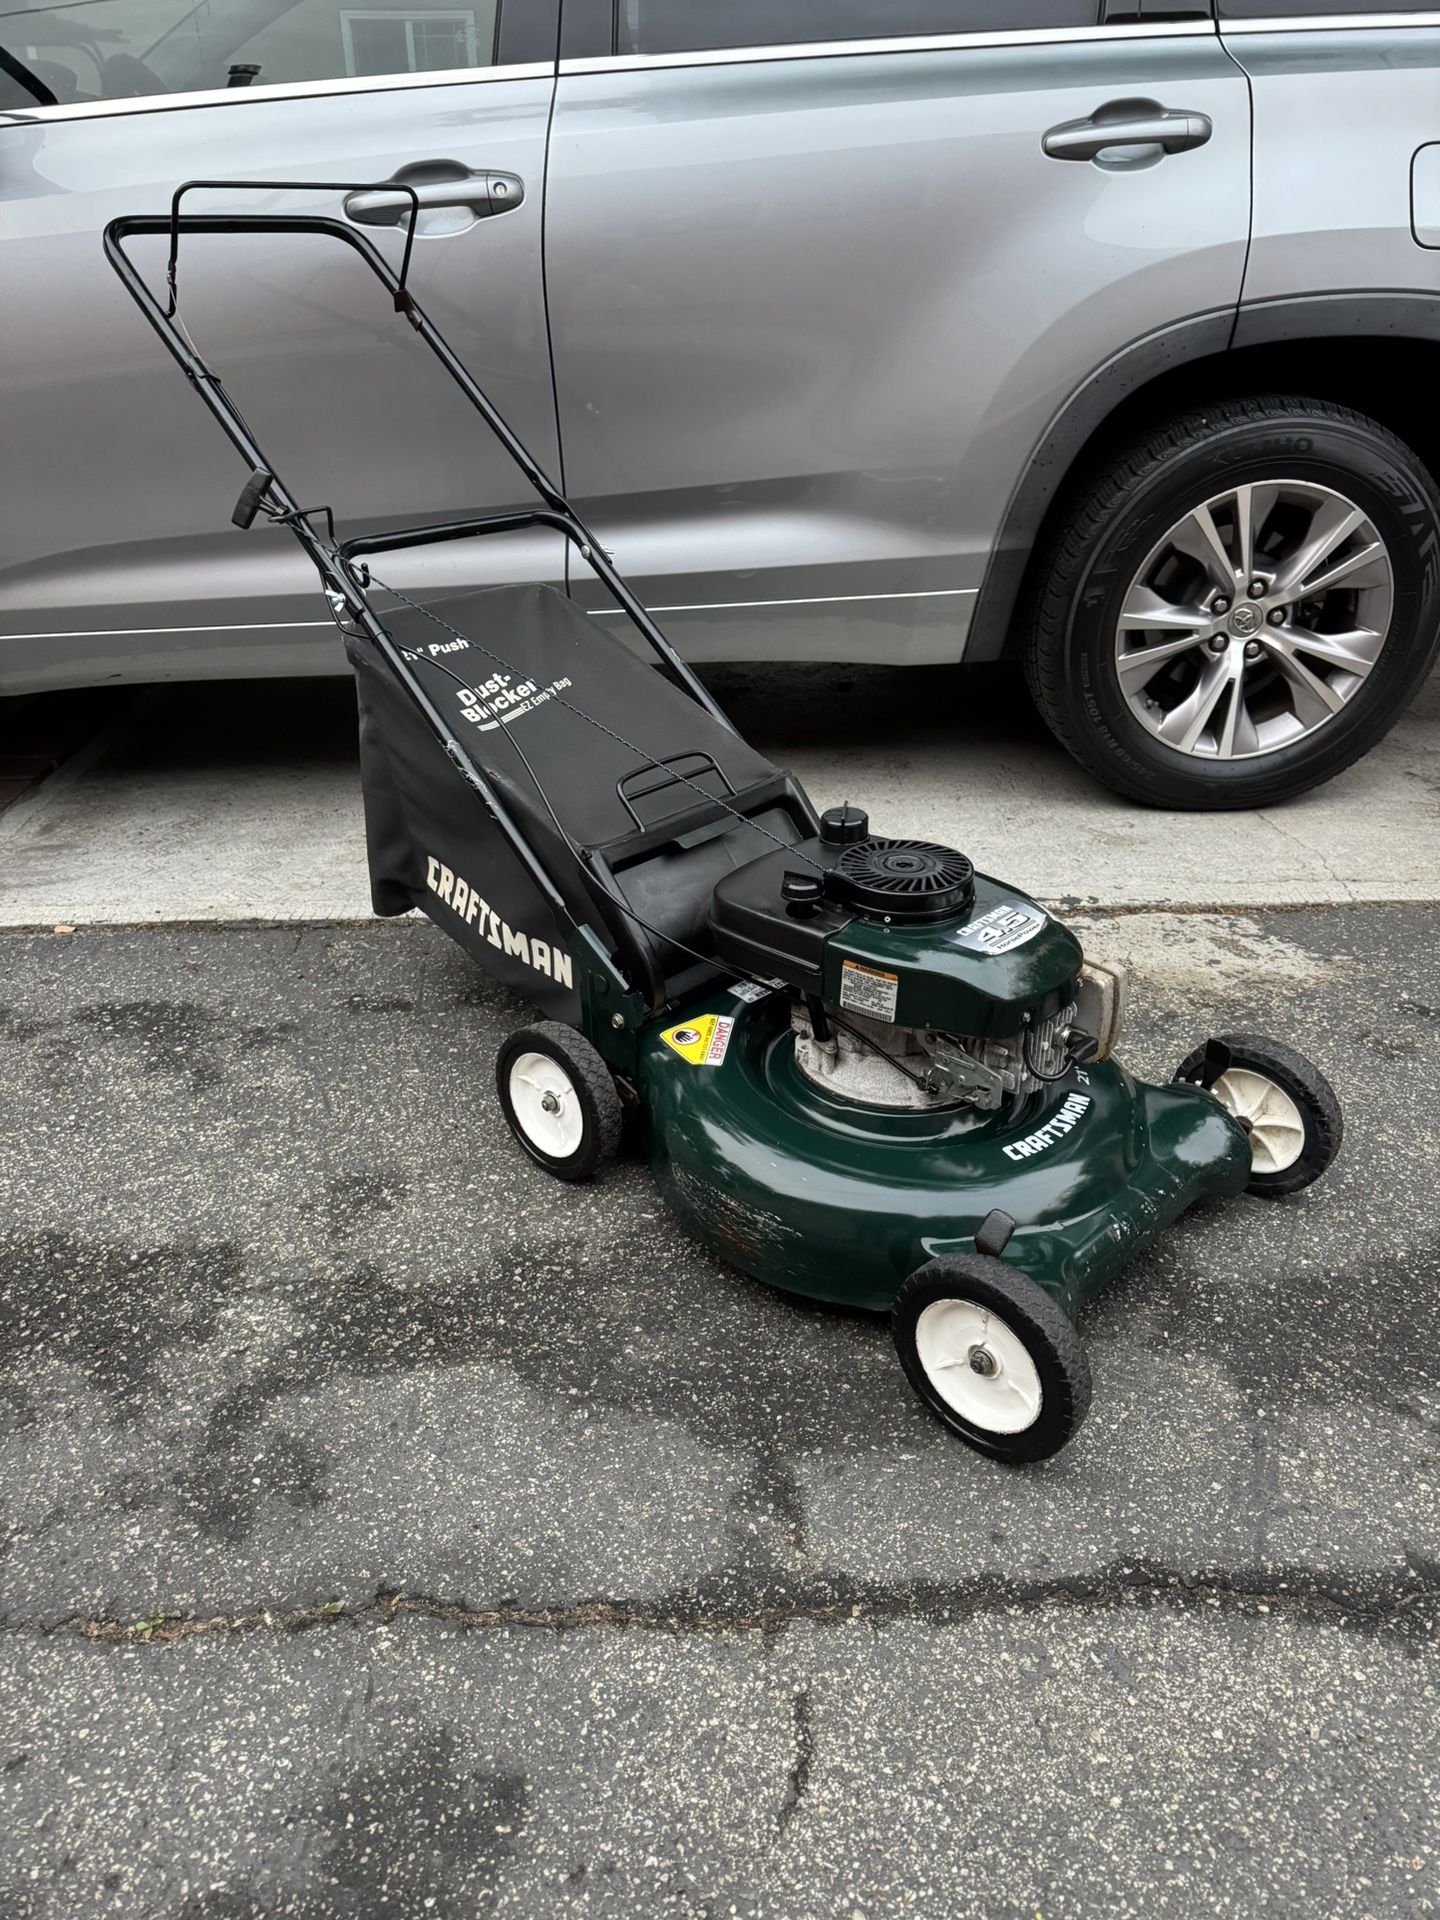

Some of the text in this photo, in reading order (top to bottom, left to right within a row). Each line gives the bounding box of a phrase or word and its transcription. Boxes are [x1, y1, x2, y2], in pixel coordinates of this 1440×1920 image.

[428, 638, 469, 657] Push
[456, 673, 511, 707] Dust-
[459, 678, 537, 723] Blocker
[520, 700, 534, 712] EZ
[552, 676, 572, 692] Bag
[426, 855, 574, 990] CRAFTSMAN
[956, 904, 1014, 937] CRAFTSMAN
[708, 1021, 732, 1060] DANGER
[1001, 1092, 1092, 1161] CRAFTSMAN
